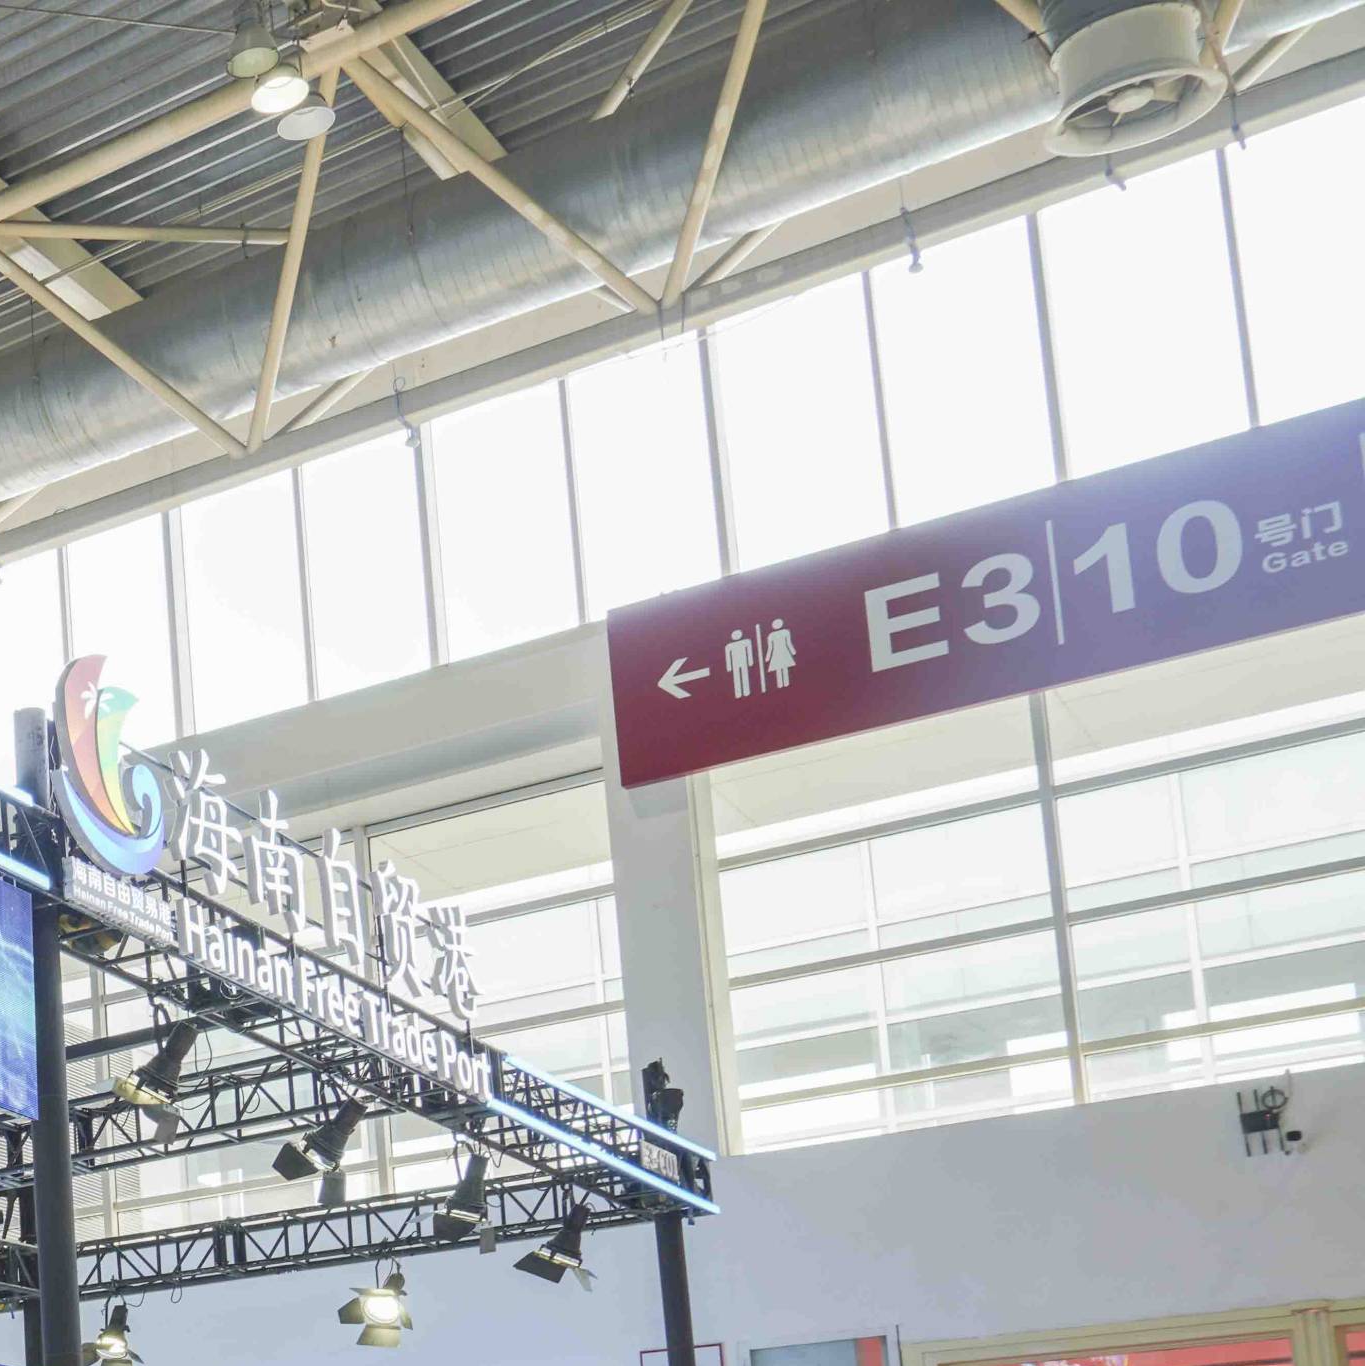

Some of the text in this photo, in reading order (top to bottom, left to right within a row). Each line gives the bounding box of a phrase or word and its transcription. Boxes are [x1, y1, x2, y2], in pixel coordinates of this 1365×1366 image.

[865, 500, 1244, 673] E3 10
[1254, 501, 1343, 548] 号门
[1261, 540, 1349, 573] Gate
[170, 748, 486, 1022] 海南自贸港
[181, 898, 493, 1102] Hainan Free Trade Port
